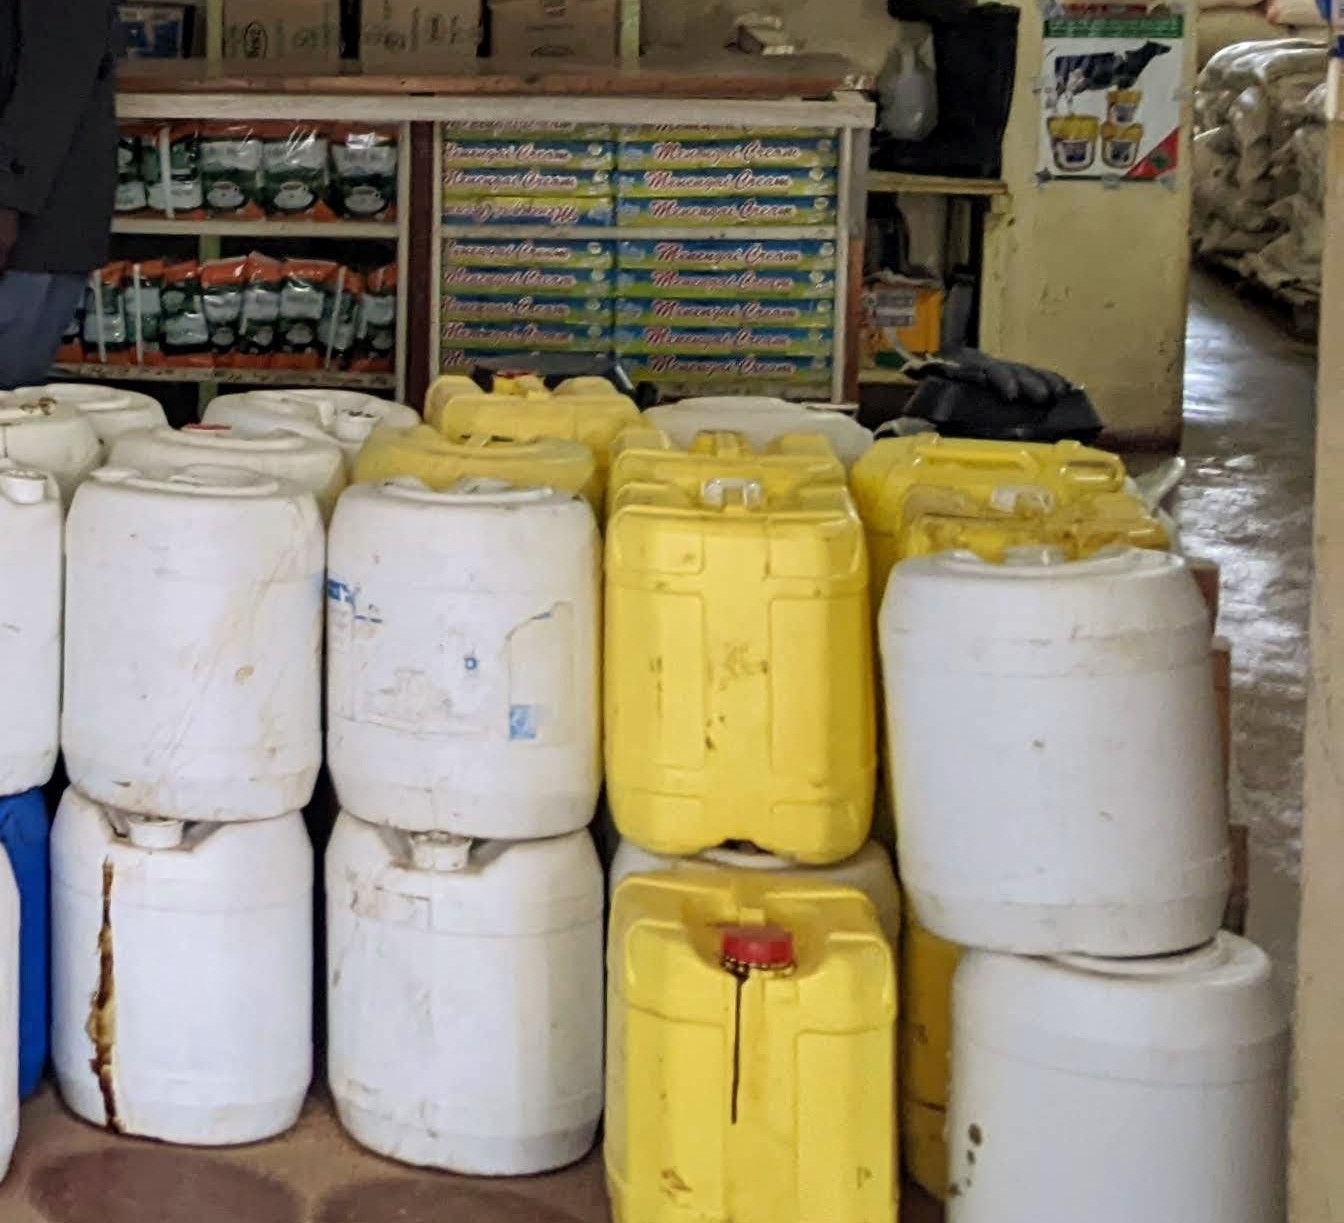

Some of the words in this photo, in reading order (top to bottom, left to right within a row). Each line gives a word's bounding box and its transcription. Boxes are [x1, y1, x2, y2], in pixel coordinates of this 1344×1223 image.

[652, 142, 735, 165] Menengai
[740, 140, 801, 160] Cream
[645, 170, 731, 191] Menengai
[733, 168, 792, 190] Cream
[649, 199, 735, 218] Menengai
[740, 198, 797, 217] Cream
[652, 242, 742, 264] Menengai
[744, 243, 803, 262] Cream
[651, 270, 732, 290] Menengai
[737, 271, 795, 288] Cream
[651, 300, 739, 319] Menengai
[742, 300, 799, 319] Cream
[645, 328, 732, 349] Menengai
[739, 329, 792, 347] Cream
[649, 355, 737, 375] Menengai
[740, 356, 797, 374] Cream
